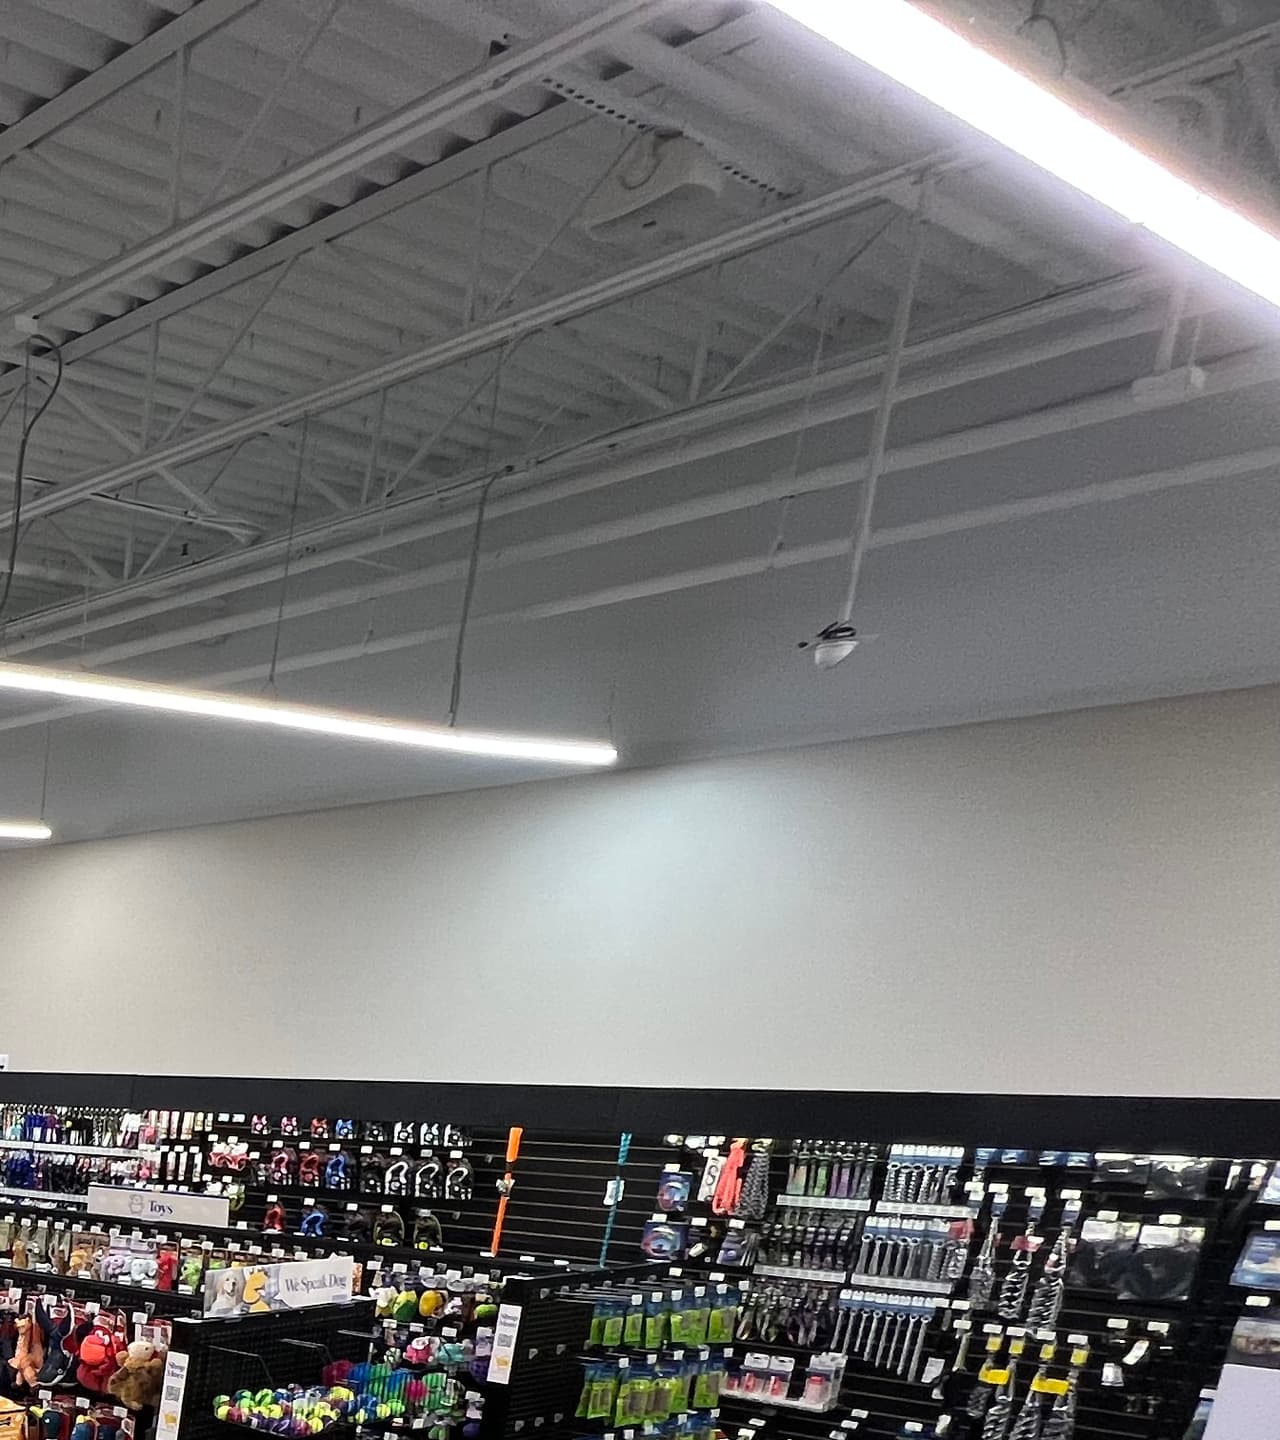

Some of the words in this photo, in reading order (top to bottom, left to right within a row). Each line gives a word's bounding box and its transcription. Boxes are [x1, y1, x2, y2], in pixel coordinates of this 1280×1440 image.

[148, 1200, 173, 1216] Toys
[286, 1278, 299, 1292] We
[300, 1274, 327, 1294] Speak
[327, 1273, 347, 1289] Dog
